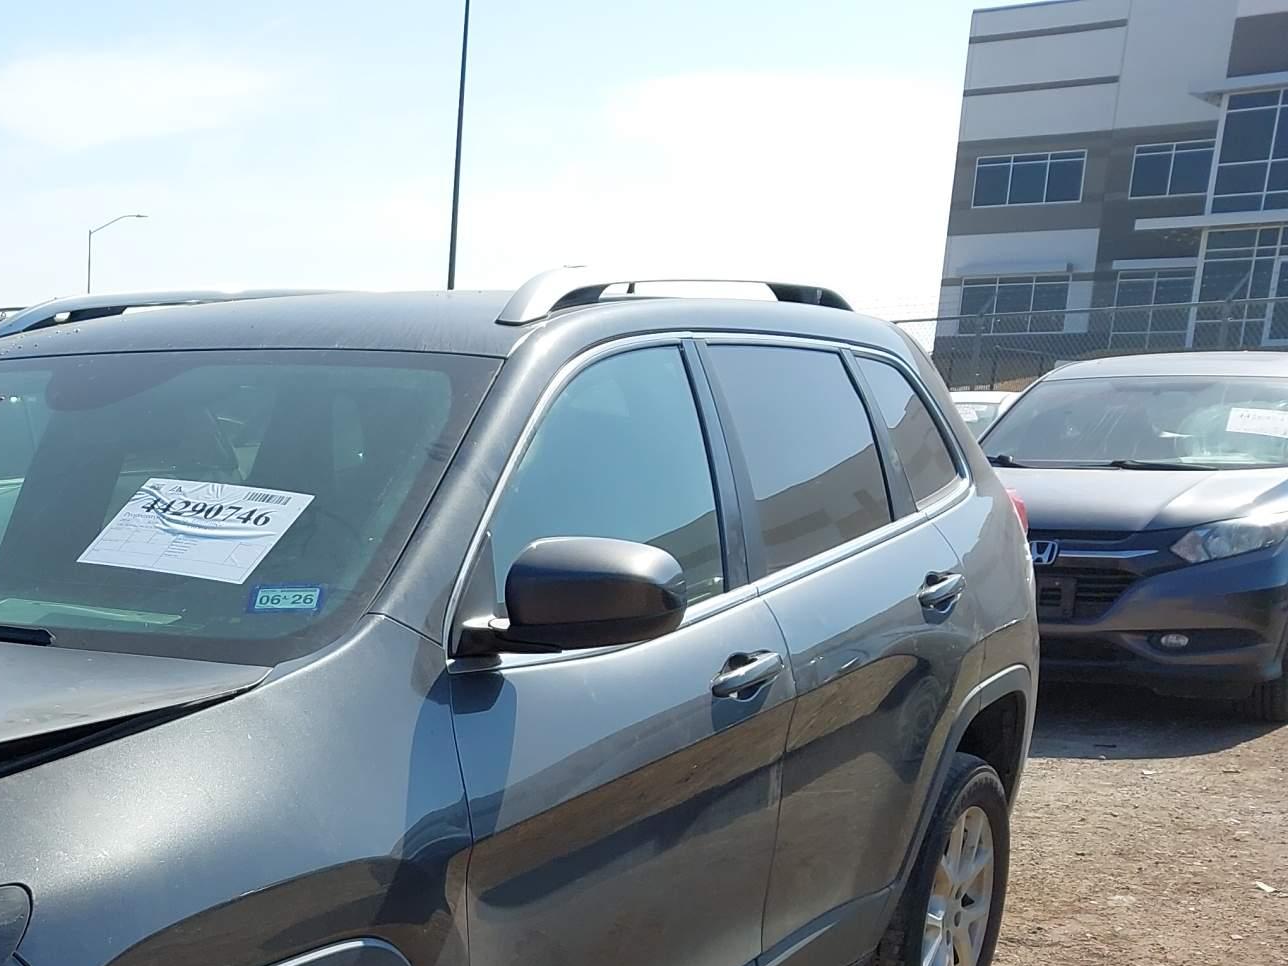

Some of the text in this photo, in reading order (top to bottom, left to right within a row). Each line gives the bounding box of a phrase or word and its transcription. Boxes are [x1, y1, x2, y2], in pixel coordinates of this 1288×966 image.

[142, 499, 276, 527] 44290746
[259, 594, 314, 605] 06 26
